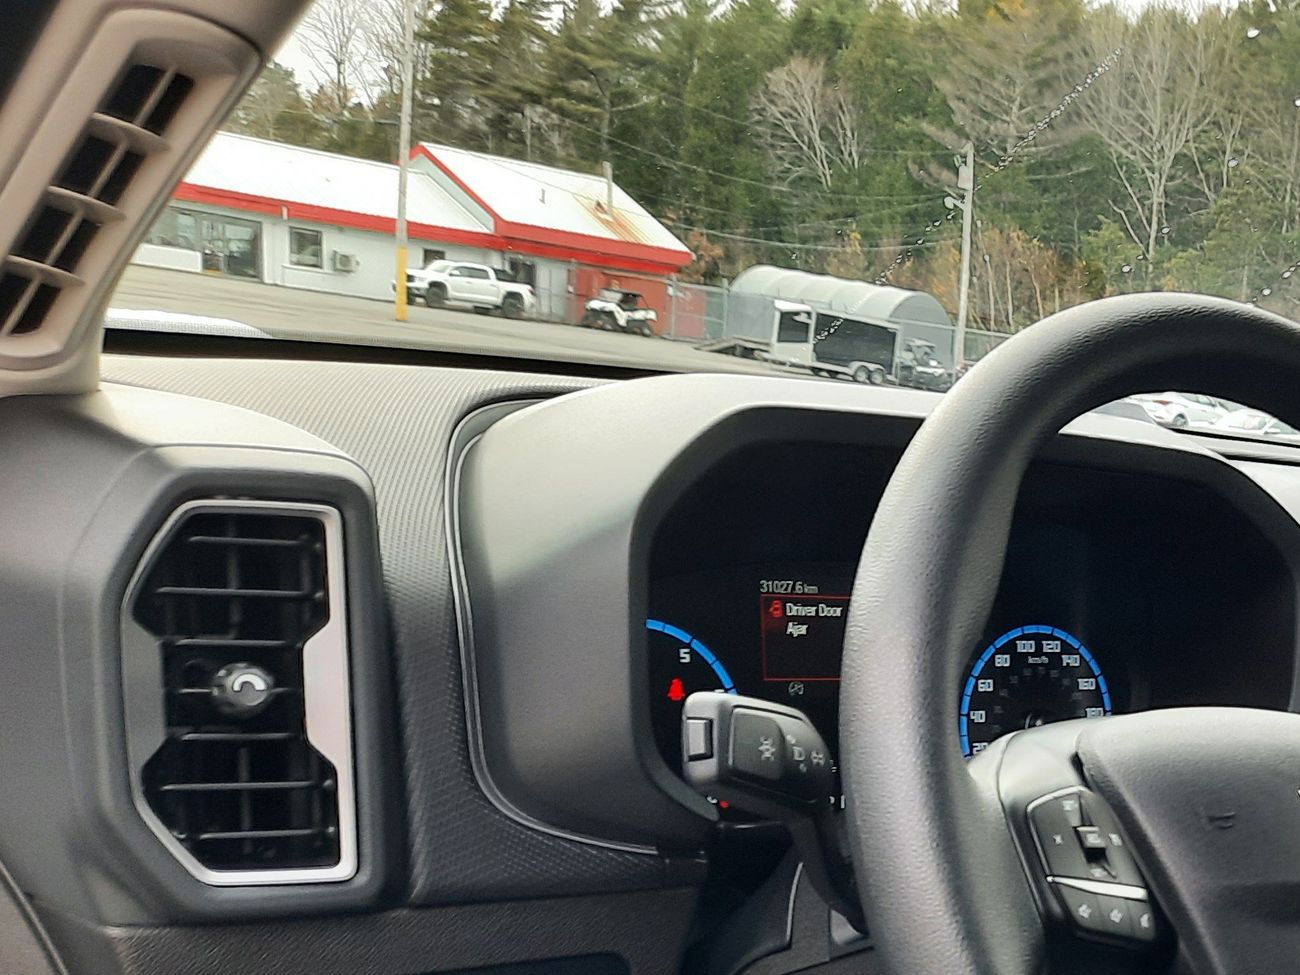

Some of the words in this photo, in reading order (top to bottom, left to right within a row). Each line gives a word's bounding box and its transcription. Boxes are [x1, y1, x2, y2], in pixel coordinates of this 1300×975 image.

[760, 580, 803, 593] 31027.6
[786, 603, 817, 616] Driver
[818, 604, 842, 617] Door
[786, 622, 808, 637] Ajar
[1016, 640, 1035, 652] 100
[1042, 640, 1061, 652] 120
[679, 648, 691, 663] 5
[994, 654, 1010, 667] 80
[1062, 654, 1080, 666] 140
[978, 679, 993, 692] 60
[1077, 678, 1096, 690] 160
[970, 710, 985, 723] 40
